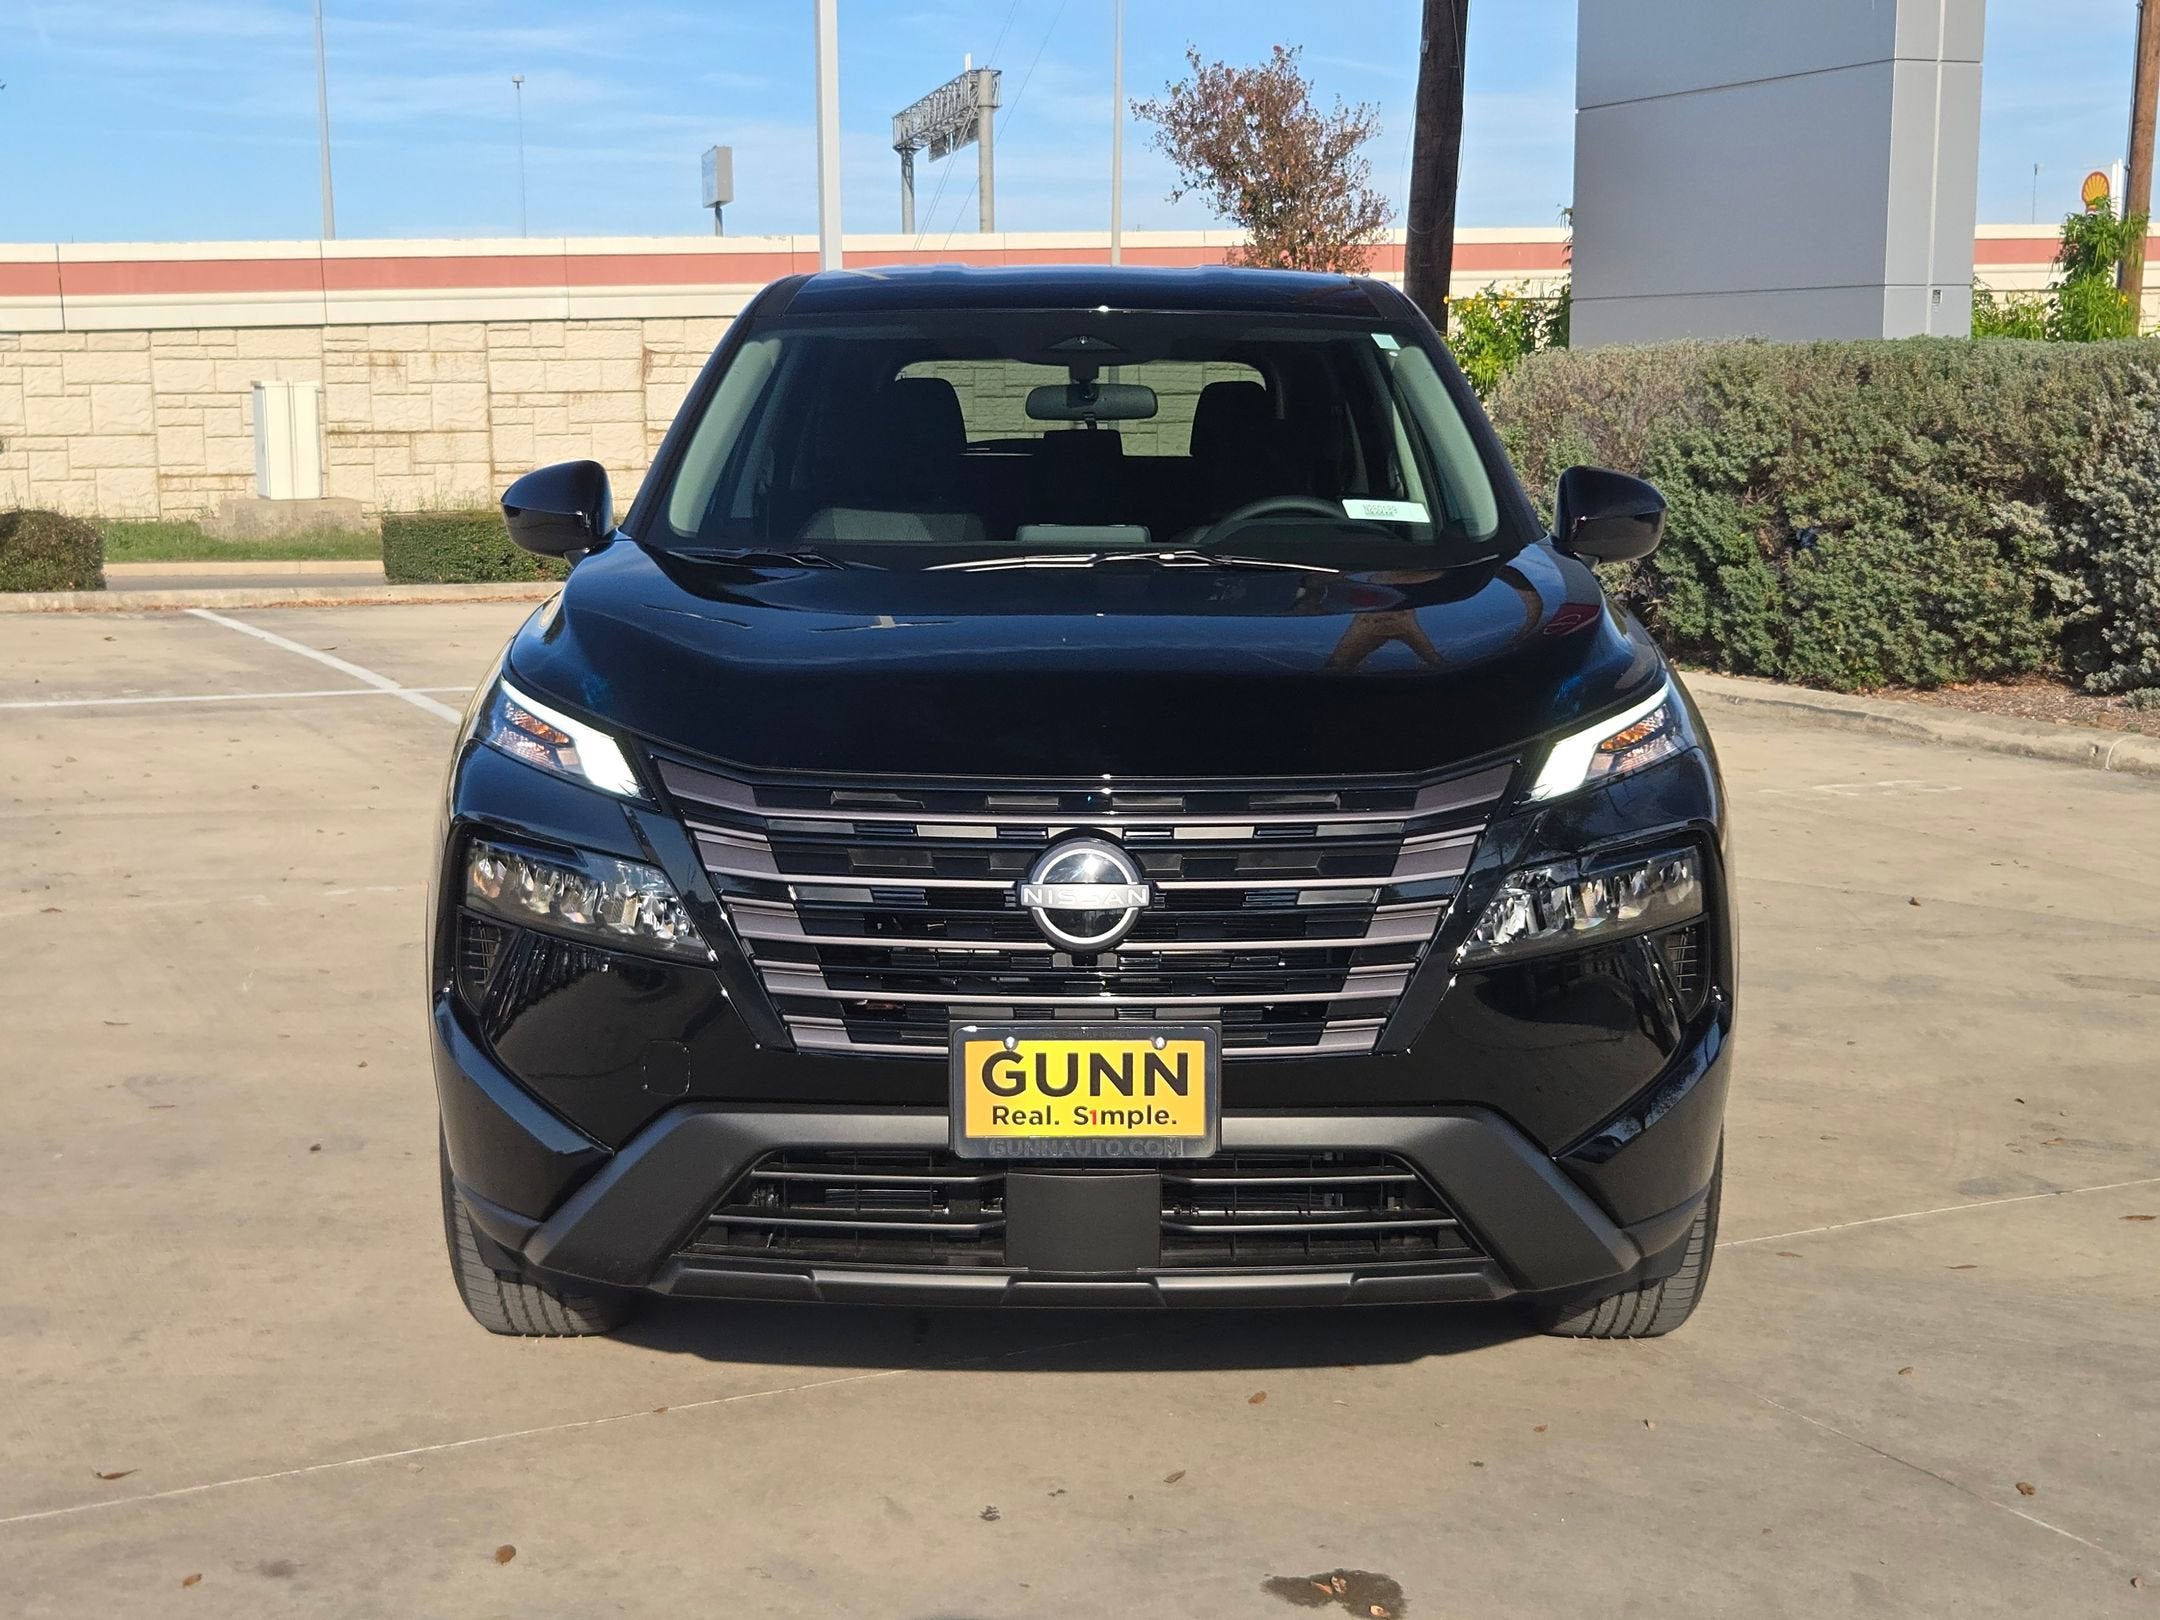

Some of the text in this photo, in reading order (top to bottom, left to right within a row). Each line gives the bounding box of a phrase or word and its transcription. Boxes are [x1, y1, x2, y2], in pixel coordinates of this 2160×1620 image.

[1023, 888, 1148, 906] NISSAN
[981, 1051, 1189, 1098] GUNN
[992, 1105, 1060, 1126] Real.
[988, 1139, 1184, 1158] GUNNAUTO.COM
